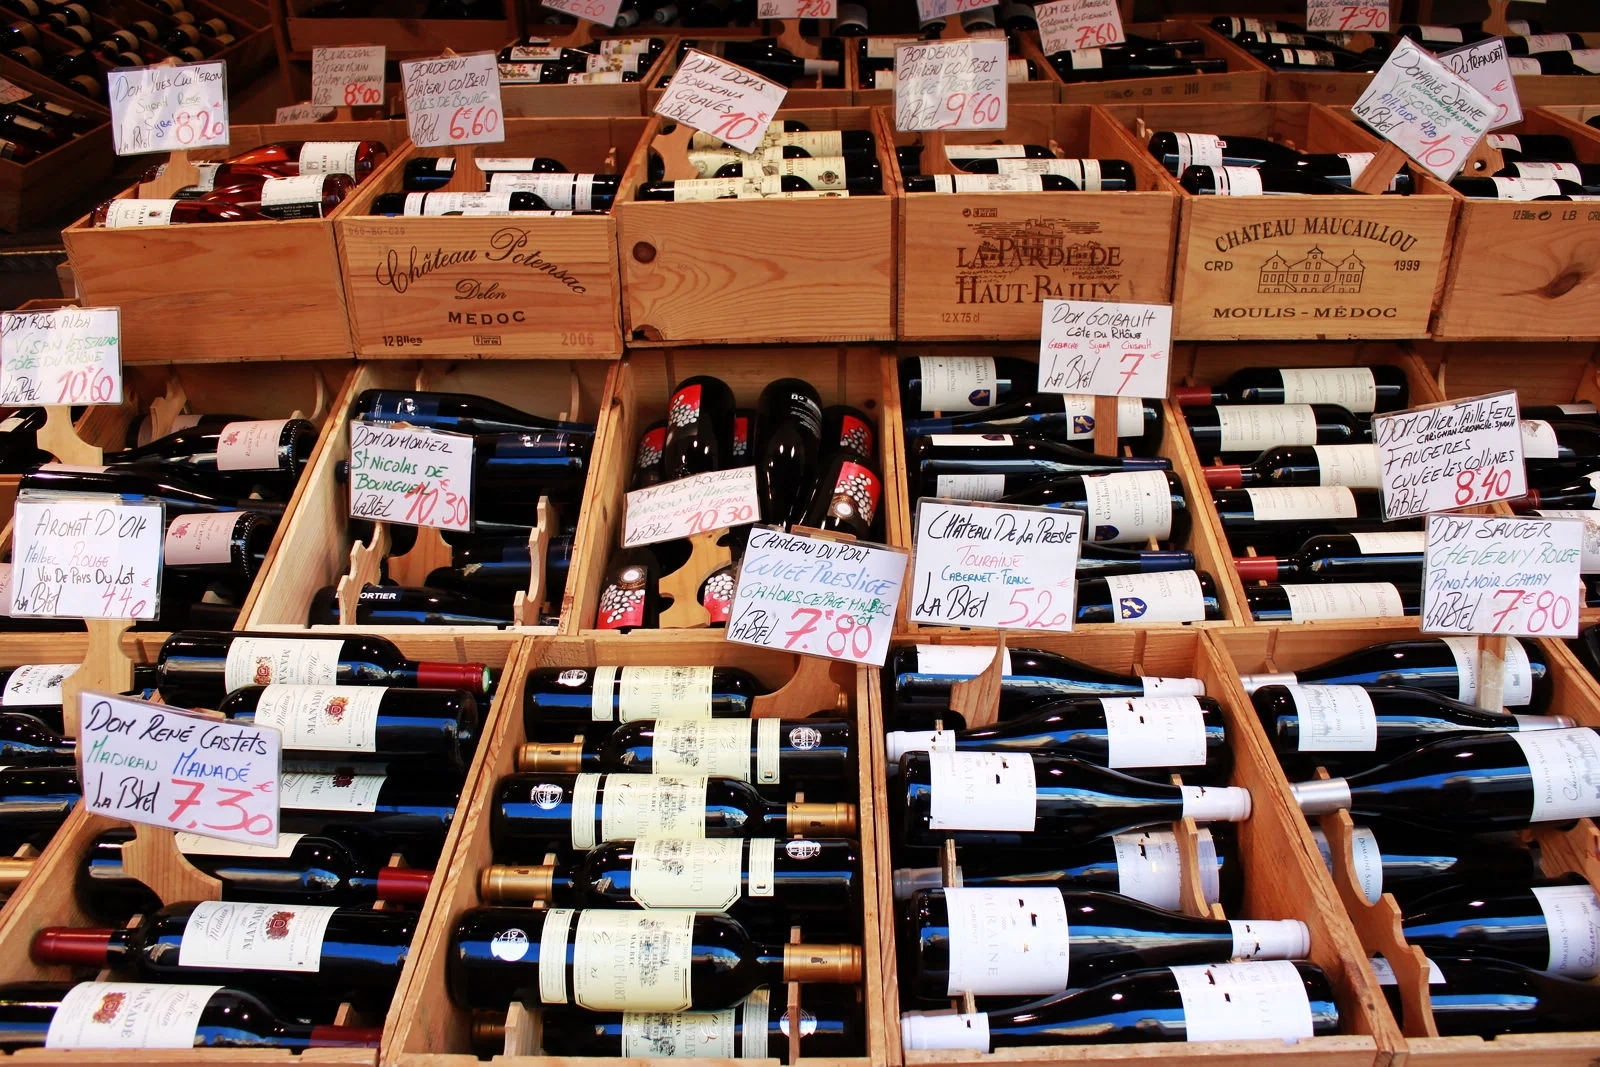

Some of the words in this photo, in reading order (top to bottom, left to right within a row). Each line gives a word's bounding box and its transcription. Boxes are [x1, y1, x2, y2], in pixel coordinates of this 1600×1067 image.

[902, 44, 968, 68] BORDEAUX
[1302, 216, 1419, 254] MAUCAILLOU
[484, 226, 588, 296] Potensac
[1088, 245, 1125, 269] DE
[1203, 259, 1234, 273] CRD
[1392, 258, 1421, 273] 1999
[454, 277, 508, 301] Delon
[447, 309, 527, 326] MEDOC
[940, 312, 952, 323] 12
[960, 312, 972, 323] 75
[1051, 302, 1085, 325] DOM
[1213, 306, 1297, 319] MOULIS
[1313, 304, 1398, 319] MÉDOC
[381, 334, 395, 347] 12
[560, 331, 596, 348] 2006
[1116, 353, 1146, 395] 7
[424, 464, 449, 479] DE
[1428, 515, 1474, 548] DOM
[815, 543, 836, 559] DU
[835, 545, 871, 565] PORT
[956, 543, 1025, 568] TOURAINE
[55, 567, 69, 584] DE
[71, 567, 92, 585] PAYS
[95, 568, 113, 586] DU
[359, 591, 397, 600] ORTIER
[84, 700, 137, 736] DOM
[138, 713, 196, 743] RENÉ
[199, 725, 269, 756] CASTETS
[85, 734, 159, 773] MADIRAN
